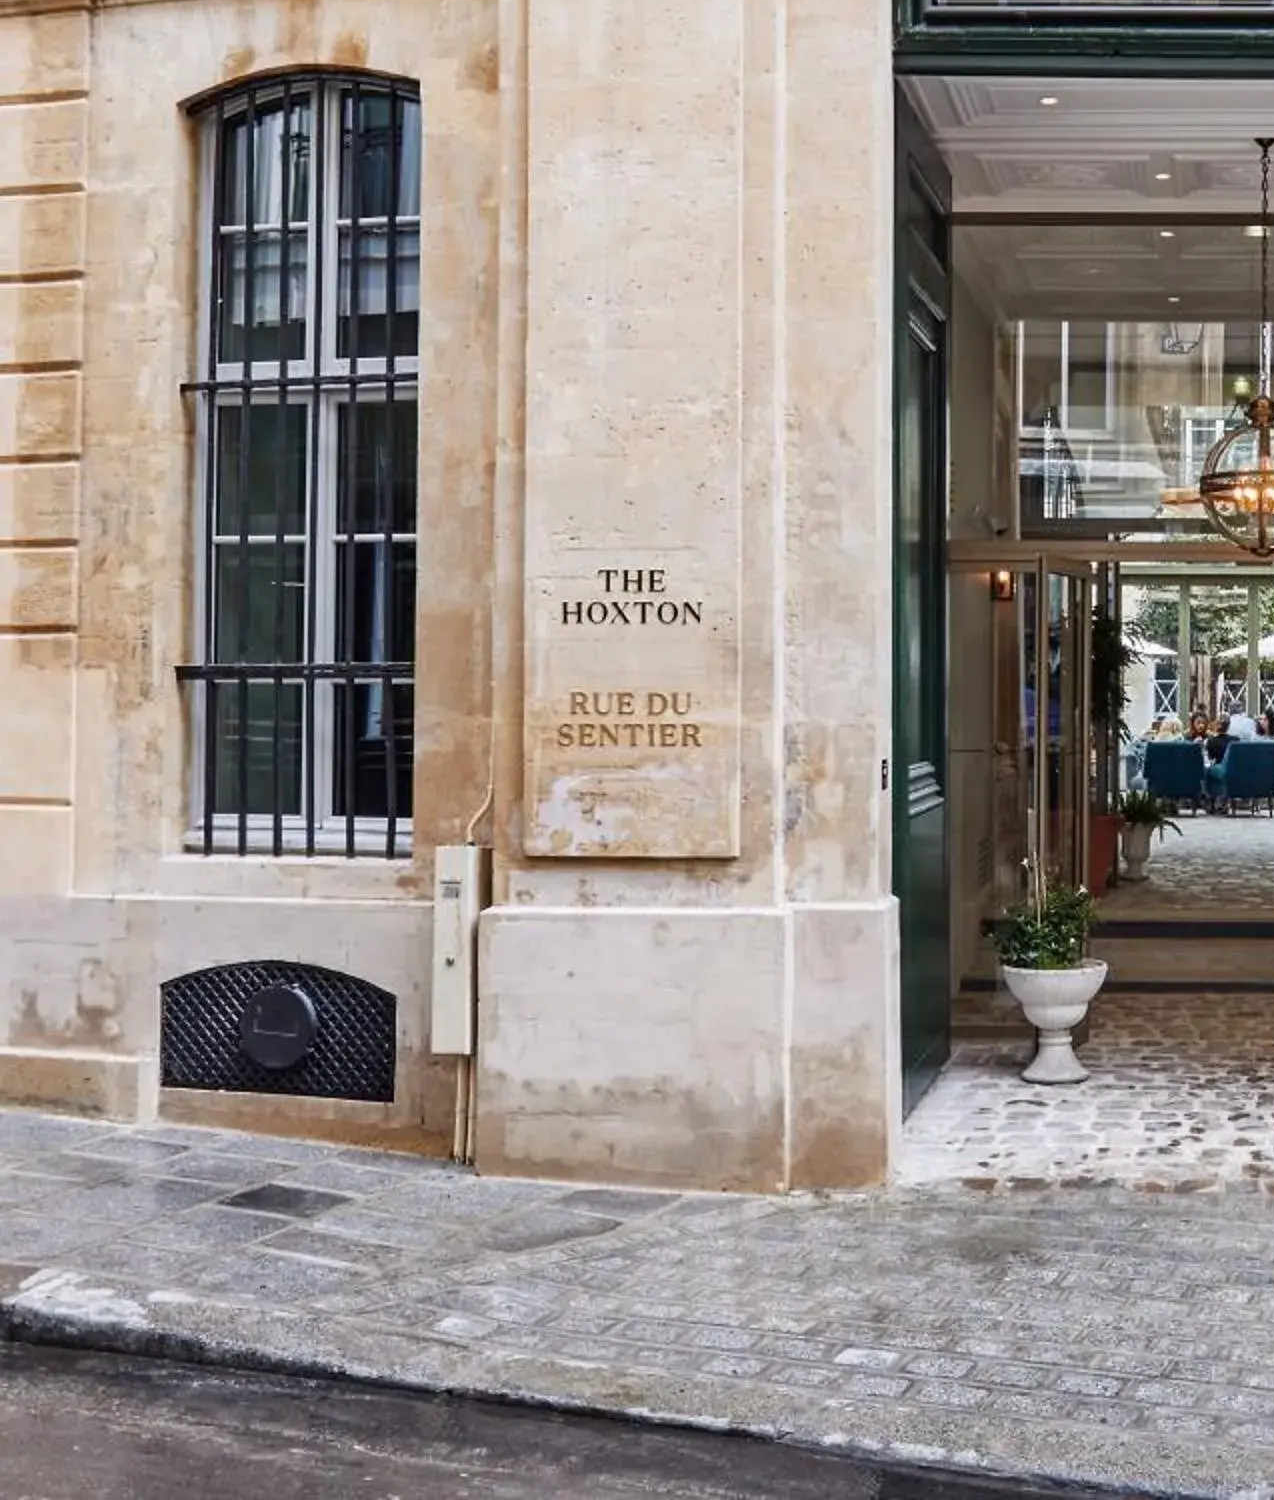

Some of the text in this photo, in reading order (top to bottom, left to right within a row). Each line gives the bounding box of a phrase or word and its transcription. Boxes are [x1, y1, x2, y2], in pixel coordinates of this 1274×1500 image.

[597, 569, 666, 593] THE
[561, 601, 703, 625] HOXTON
[569, 691, 692, 716] RUE DU
[557, 723, 702, 747] SENTIER
